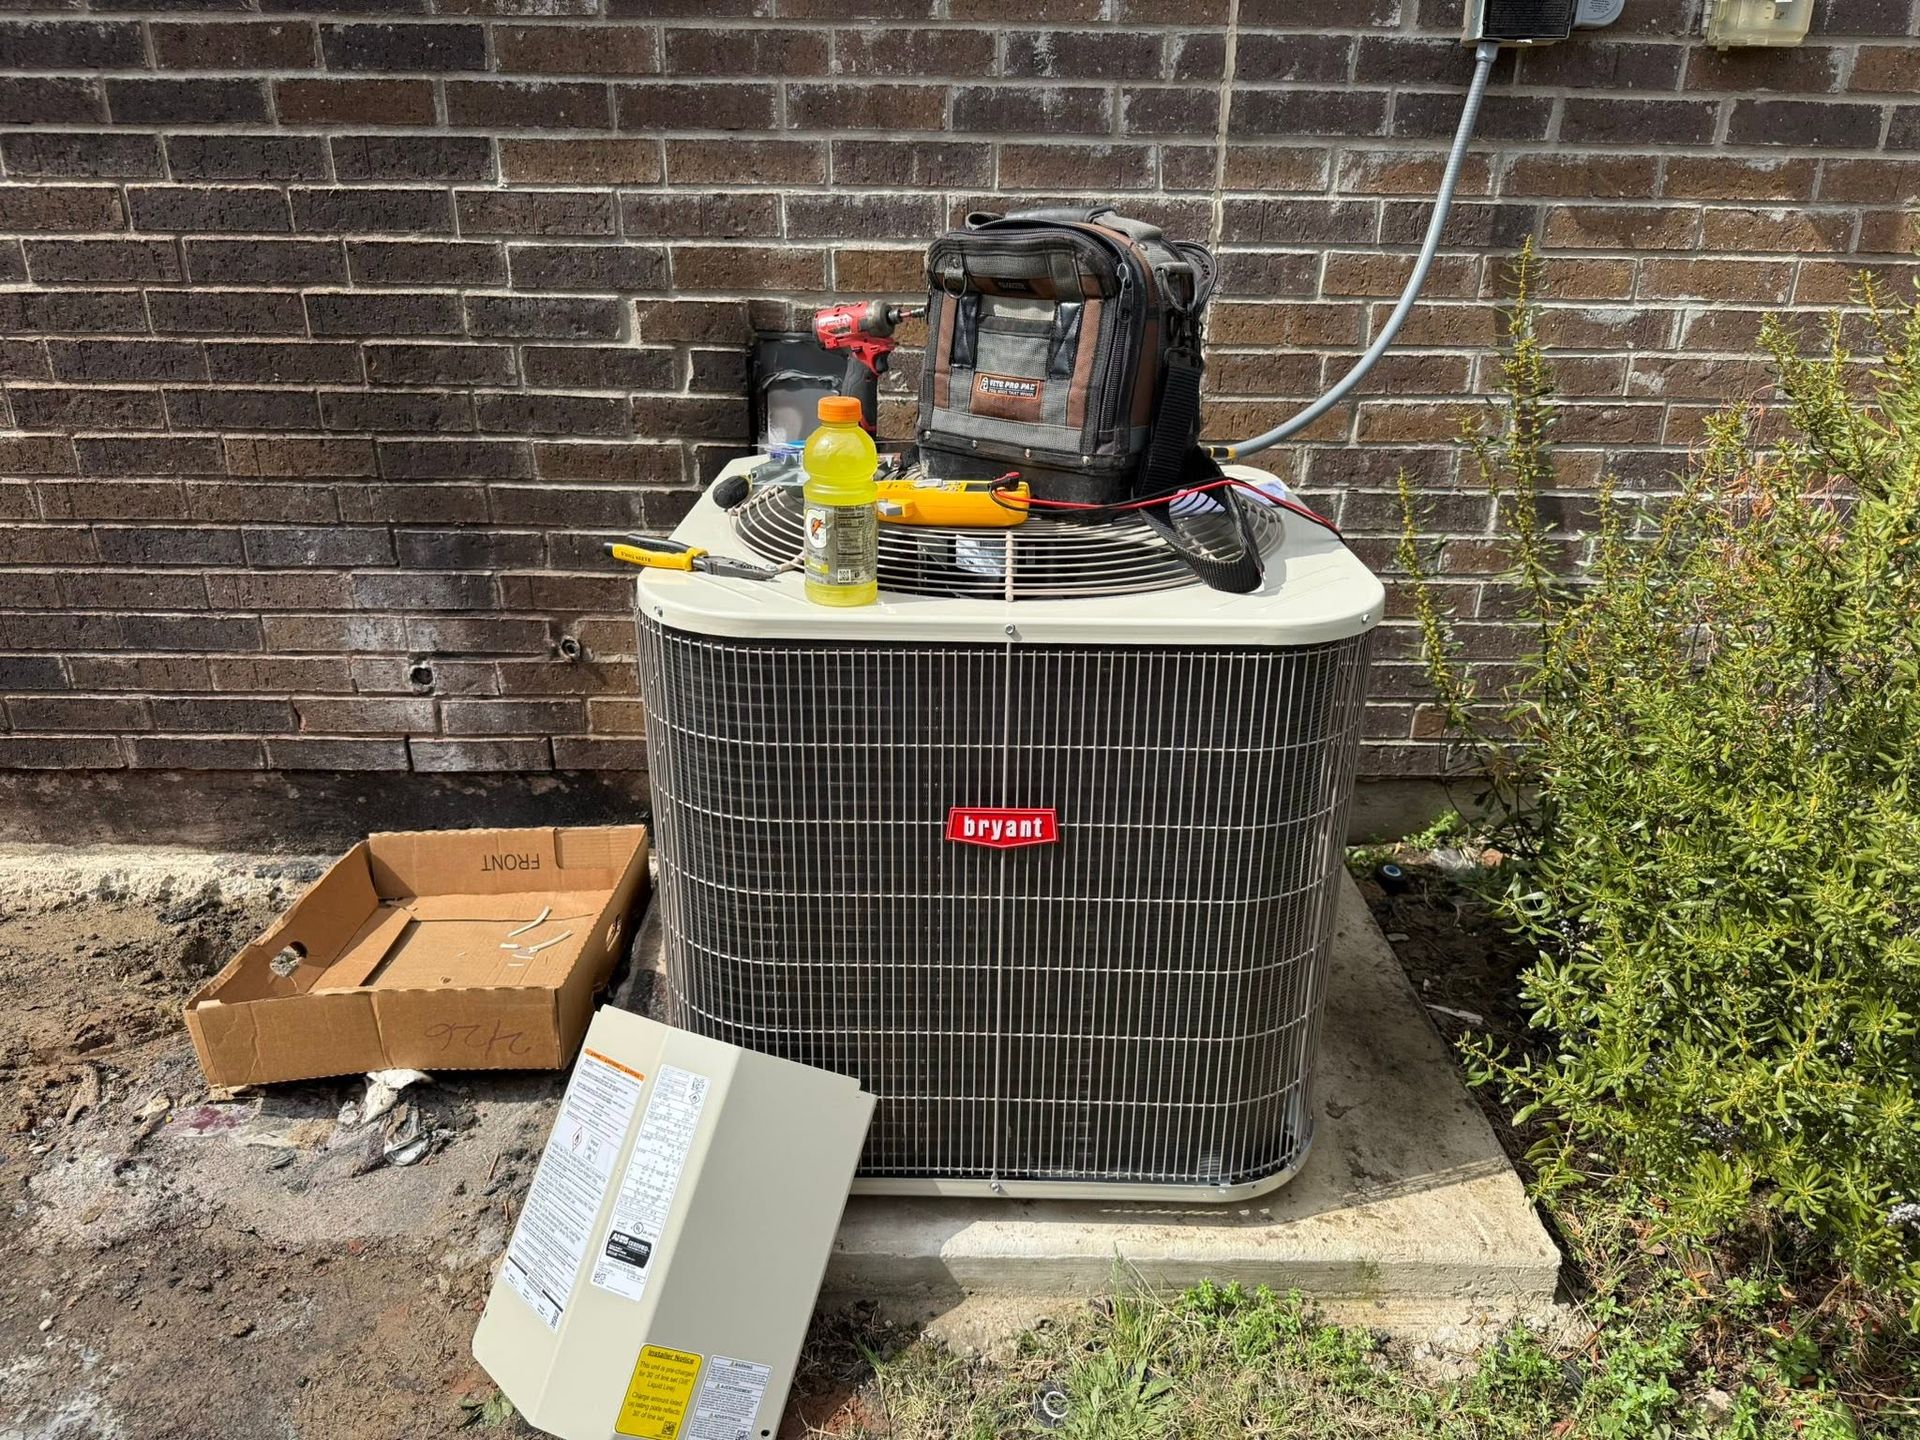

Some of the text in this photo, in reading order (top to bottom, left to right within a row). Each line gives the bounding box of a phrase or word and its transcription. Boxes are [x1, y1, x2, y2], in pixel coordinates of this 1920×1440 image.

[1005, 381, 1019, 389] PRO
[1021, 383, 1035, 391] PAC
[963, 815, 1042, 841] bryant
[481, 853, 541, 872] FRONT
[640, 1360, 650, 1368] This
[648, 1350, 694, 1364] Installer Notice
